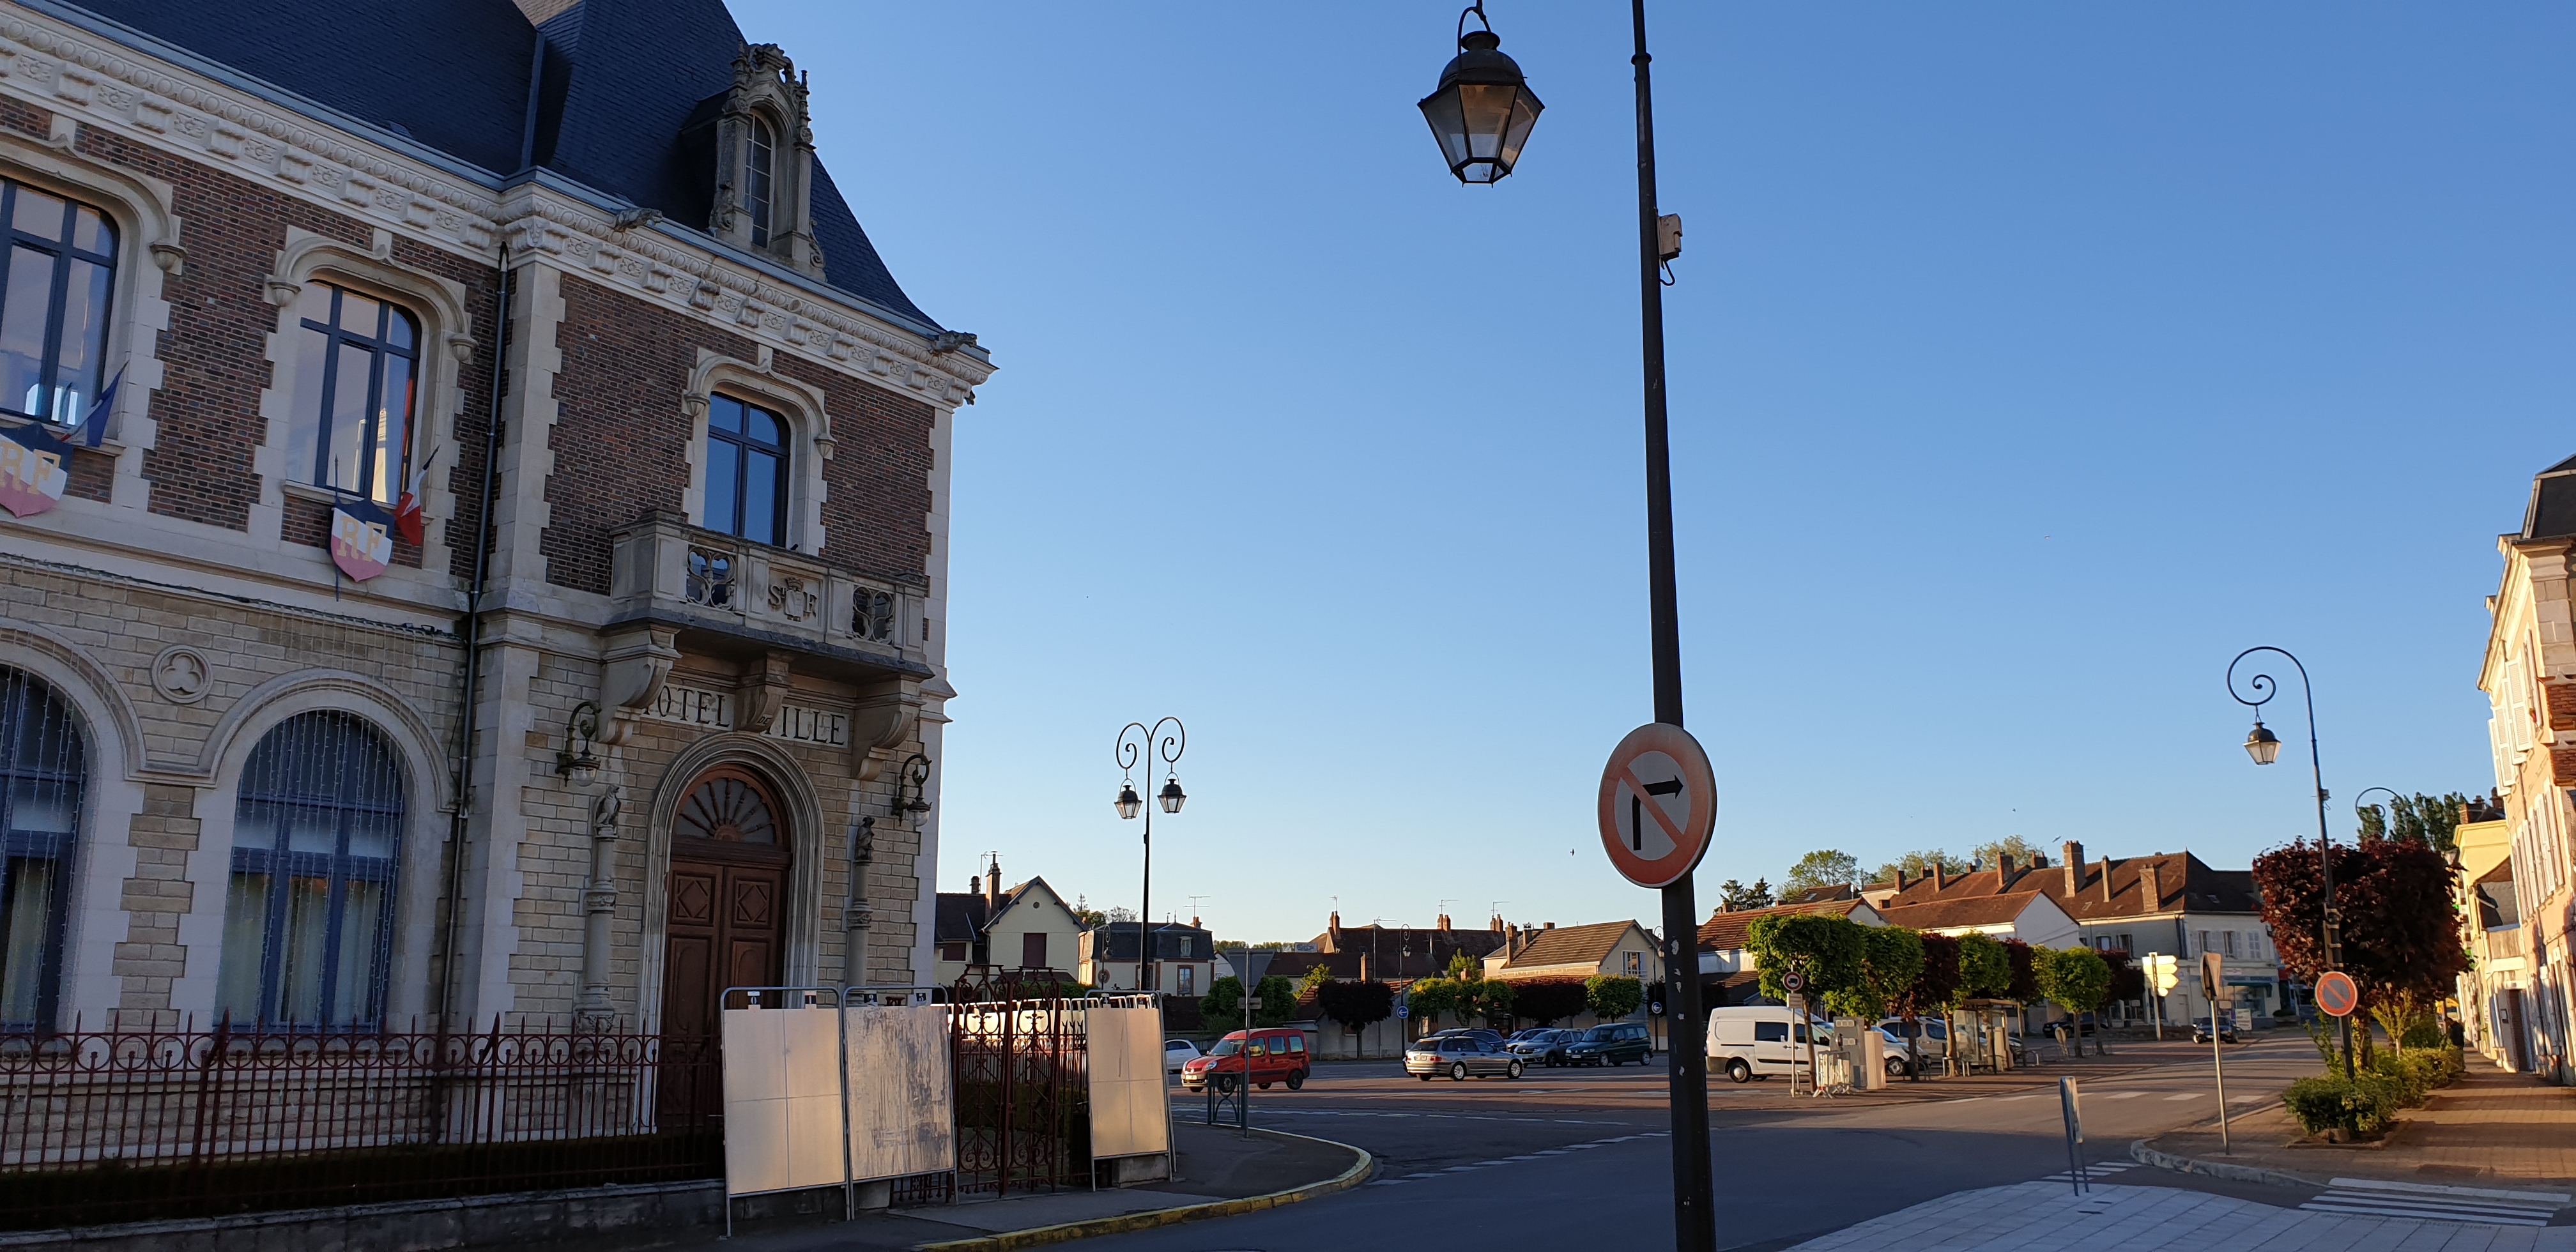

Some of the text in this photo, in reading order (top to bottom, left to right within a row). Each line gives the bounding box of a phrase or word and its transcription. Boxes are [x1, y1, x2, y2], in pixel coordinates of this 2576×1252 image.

[0, 441, 61, 496] RF
[336, 515, 387, 562] RF
[643, 685, 730, 728] OTEL
[765, 706, 845, 745] ILLE
